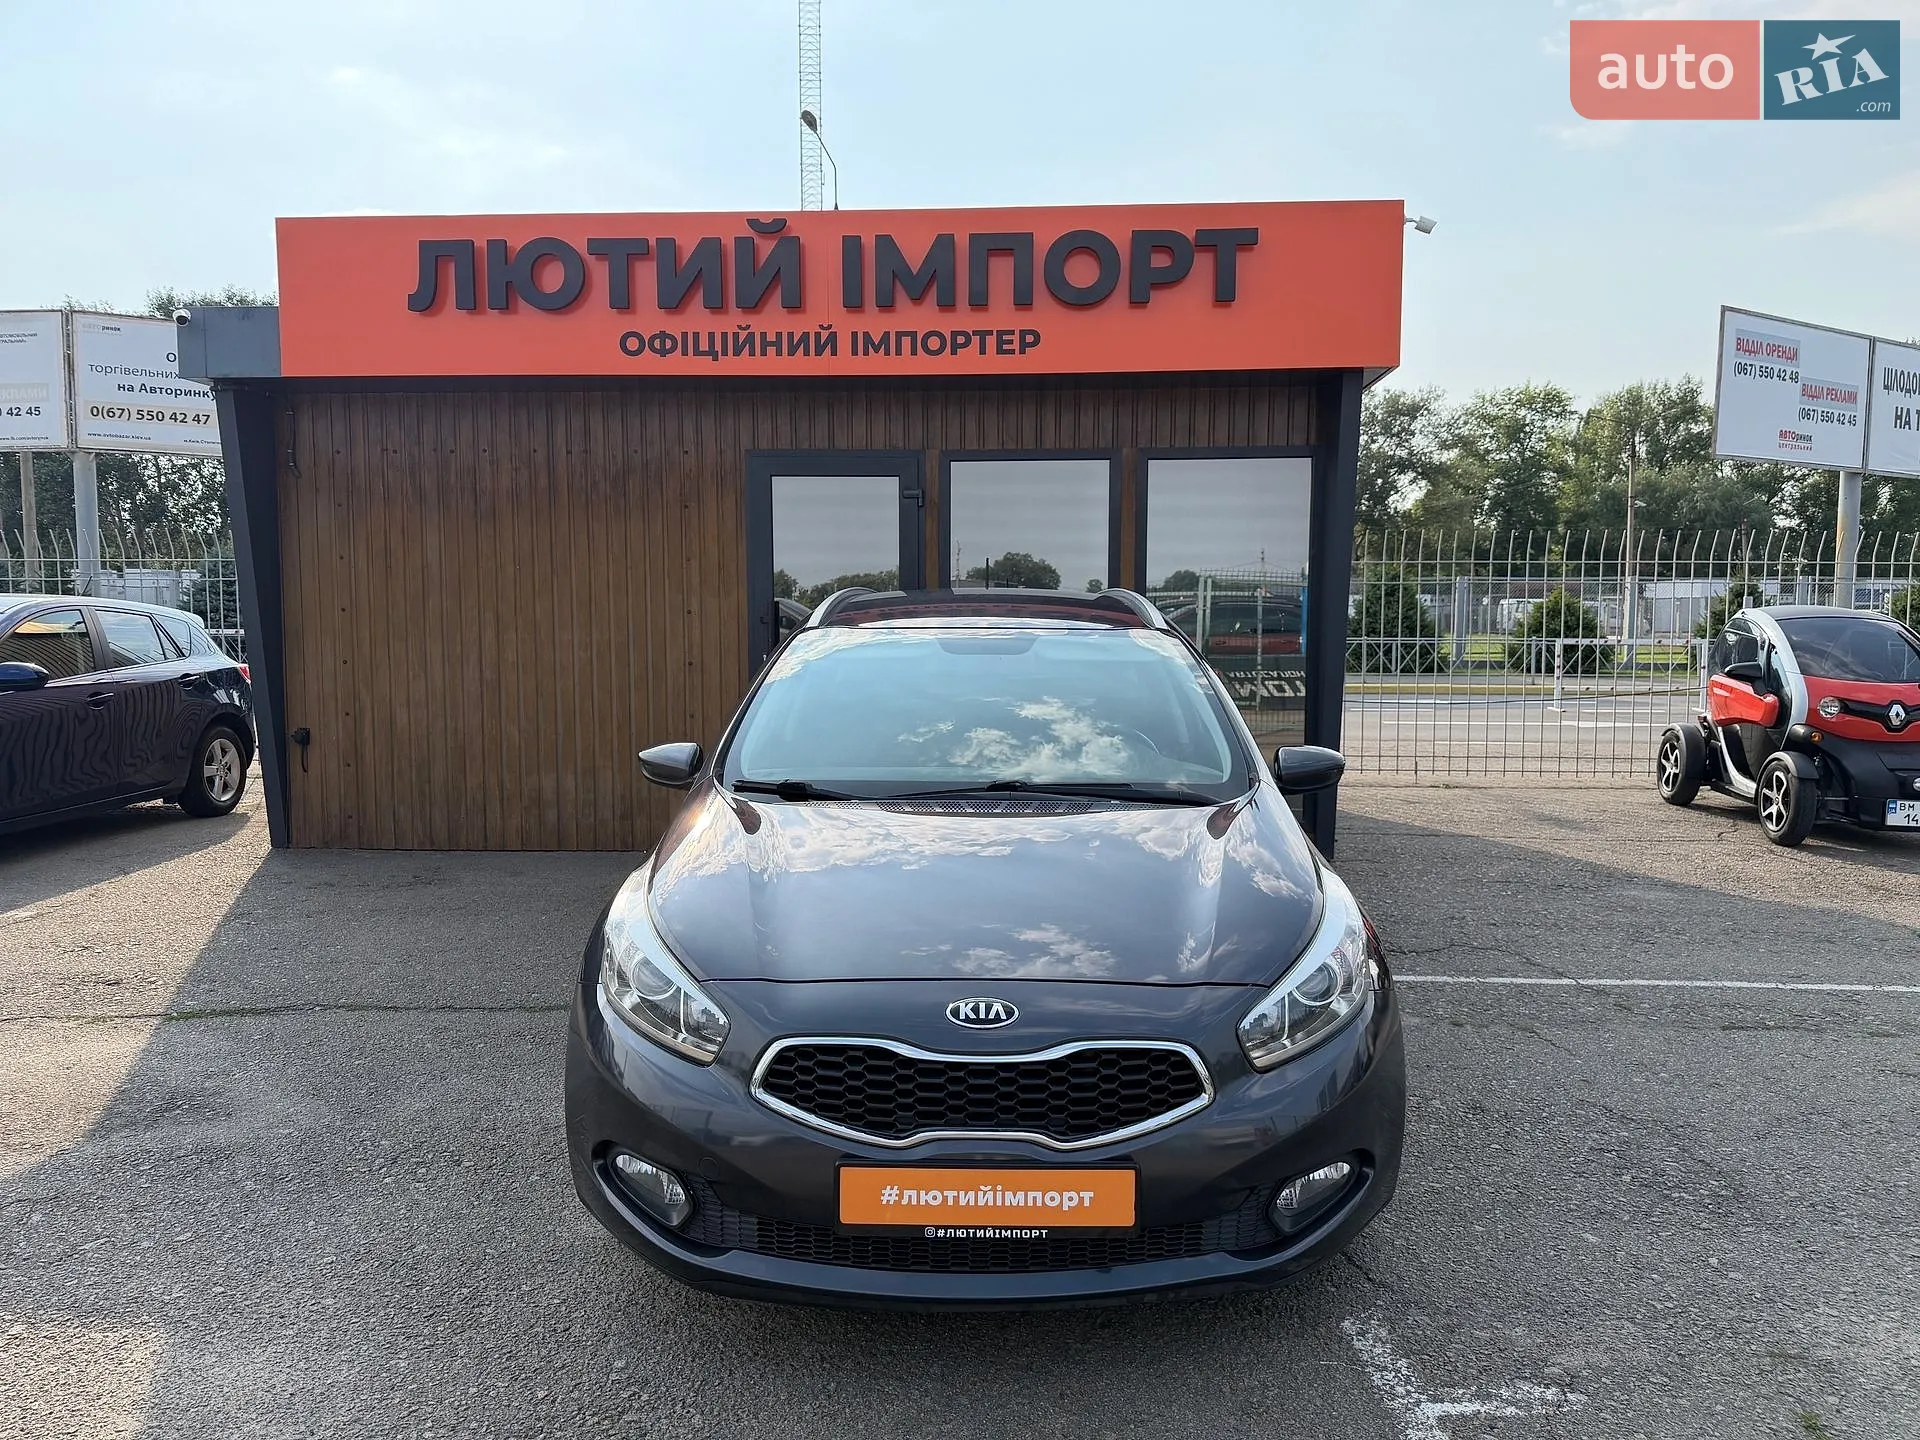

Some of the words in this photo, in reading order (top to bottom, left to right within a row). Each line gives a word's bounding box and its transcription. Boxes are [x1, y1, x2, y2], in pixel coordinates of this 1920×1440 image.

[408, 218, 802, 311] ЛЮТИЙ
[842, 227, 1260, 309] ІМПОРТ
[619, 323, 838, 362] ОФІЦІЙНИЙ
[850, 328, 1042, 357] ІМПОРТЕР
[1736, 337, 1763, 357] ВІДДІЛ
[1766, 343, 1798, 363] ОРЕНДИ
[88, 363, 181, 380] торгівельних
[1734, 361, 1757, 379] (067)
[1758, 365, 1774, 380] 550
[1776, 368, 1787, 382] 42
[1789, 370, 1800, 384] 48
[117, 383, 135, 393] на
[139, 383, 216, 401] Авторинку
[1802, 383, 1825, 402] ВІДДІЛ
[1826, 387, 1858, 405] РЕКЛАМИ
[6, 406, 22, 417] 42
[25, 406, 41, 417] 45
[90, 405, 131, 421] 0(67)
[136, 409, 165, 422] 550
[169, 412, 188, 424] 42
[192, 413, 211, 425] 47
[1798, 407, 1819, 425] (067)
[1820, 410, 1835, 424] 550
[1836, 412, 1846, 426] 42
[1847, 414, 1857, 427] 45
[1894, 406, 1911, 430] НА
[1903, 813, 1919, 825] 14
[959, 1002, 1007, 1020] KIA
[880, 1185, 1094, 1210] #лютийімпорт
[937, 1227, 1048, 1239] #ЛЮТИЙІМПОРТ
